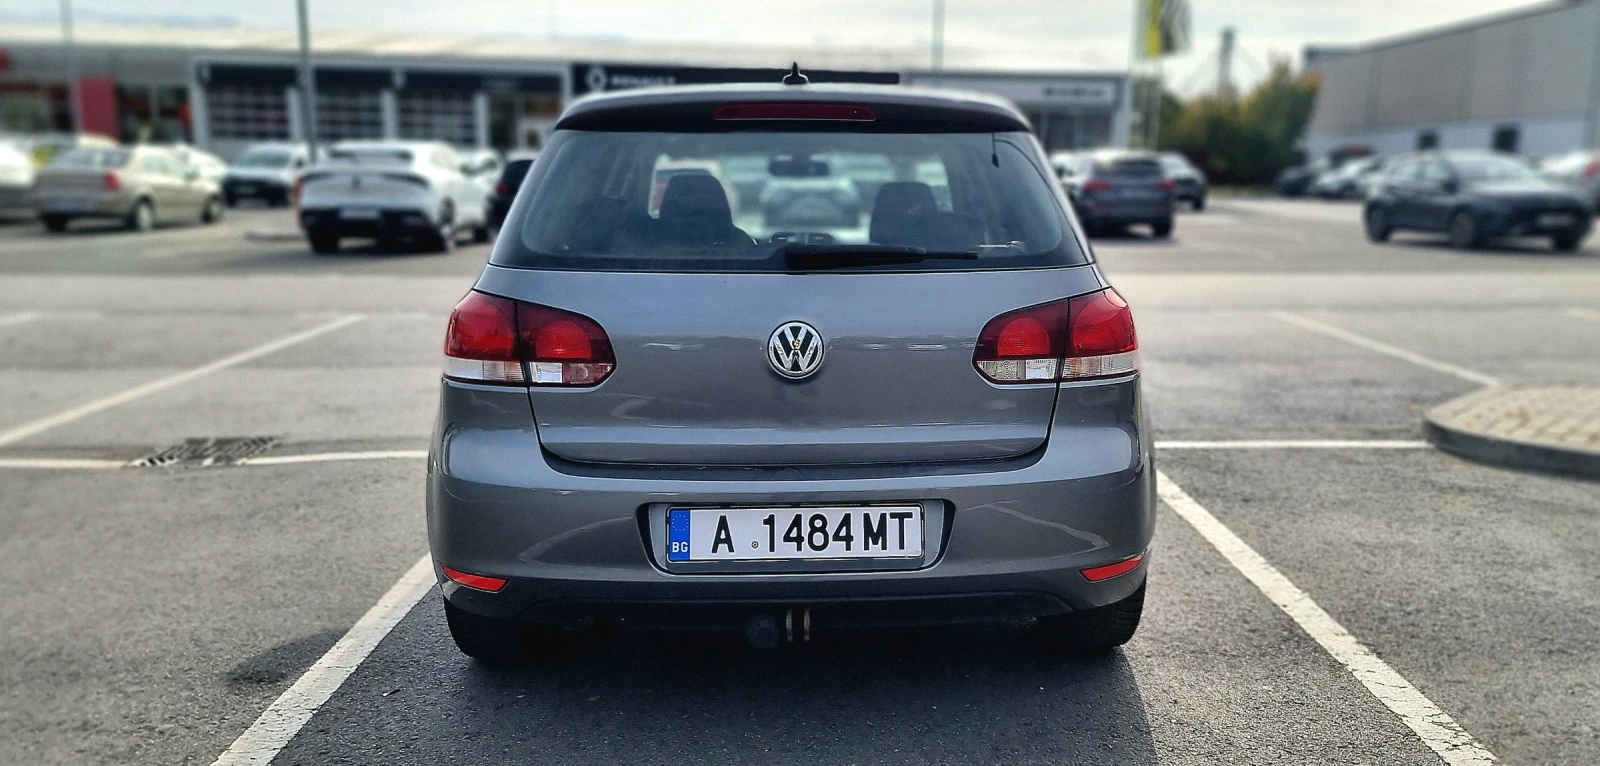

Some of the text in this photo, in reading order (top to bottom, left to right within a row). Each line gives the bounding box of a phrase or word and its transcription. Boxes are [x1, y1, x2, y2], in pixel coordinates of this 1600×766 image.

[711, 511, 914, 554] A 1484 MT
[671, 541, 689, 553] BG
